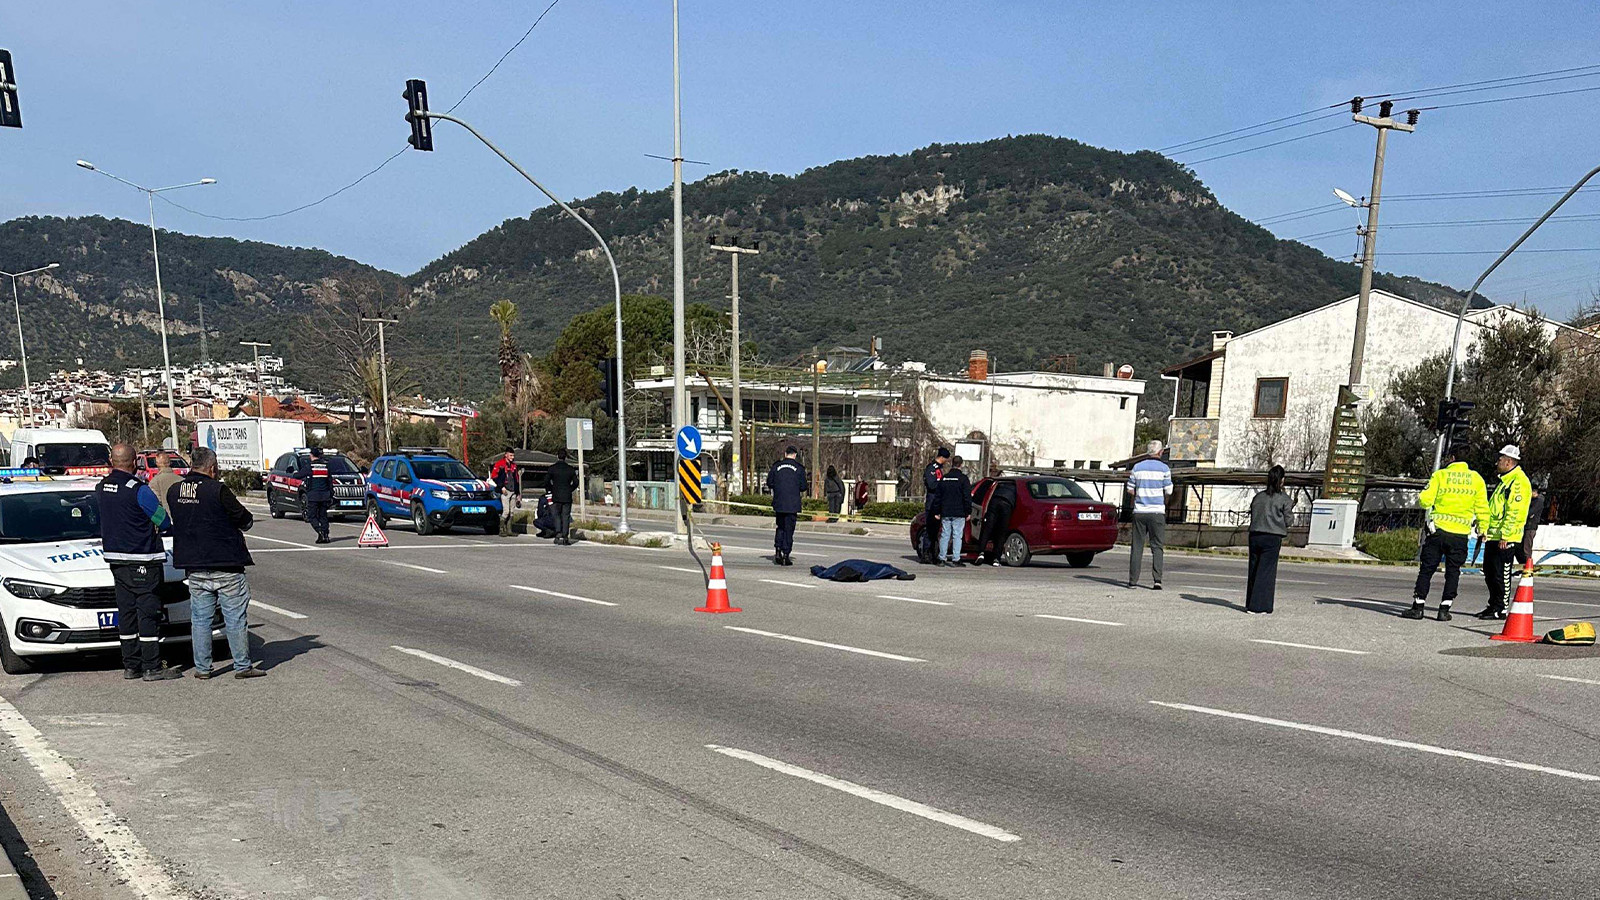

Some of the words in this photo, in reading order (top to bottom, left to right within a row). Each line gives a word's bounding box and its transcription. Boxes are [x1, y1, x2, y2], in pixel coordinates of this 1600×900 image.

[217, 428, 232, 440] BODUR
[233, 427, 247, 440] TRANS
[99, 612, 114, 625] 17
